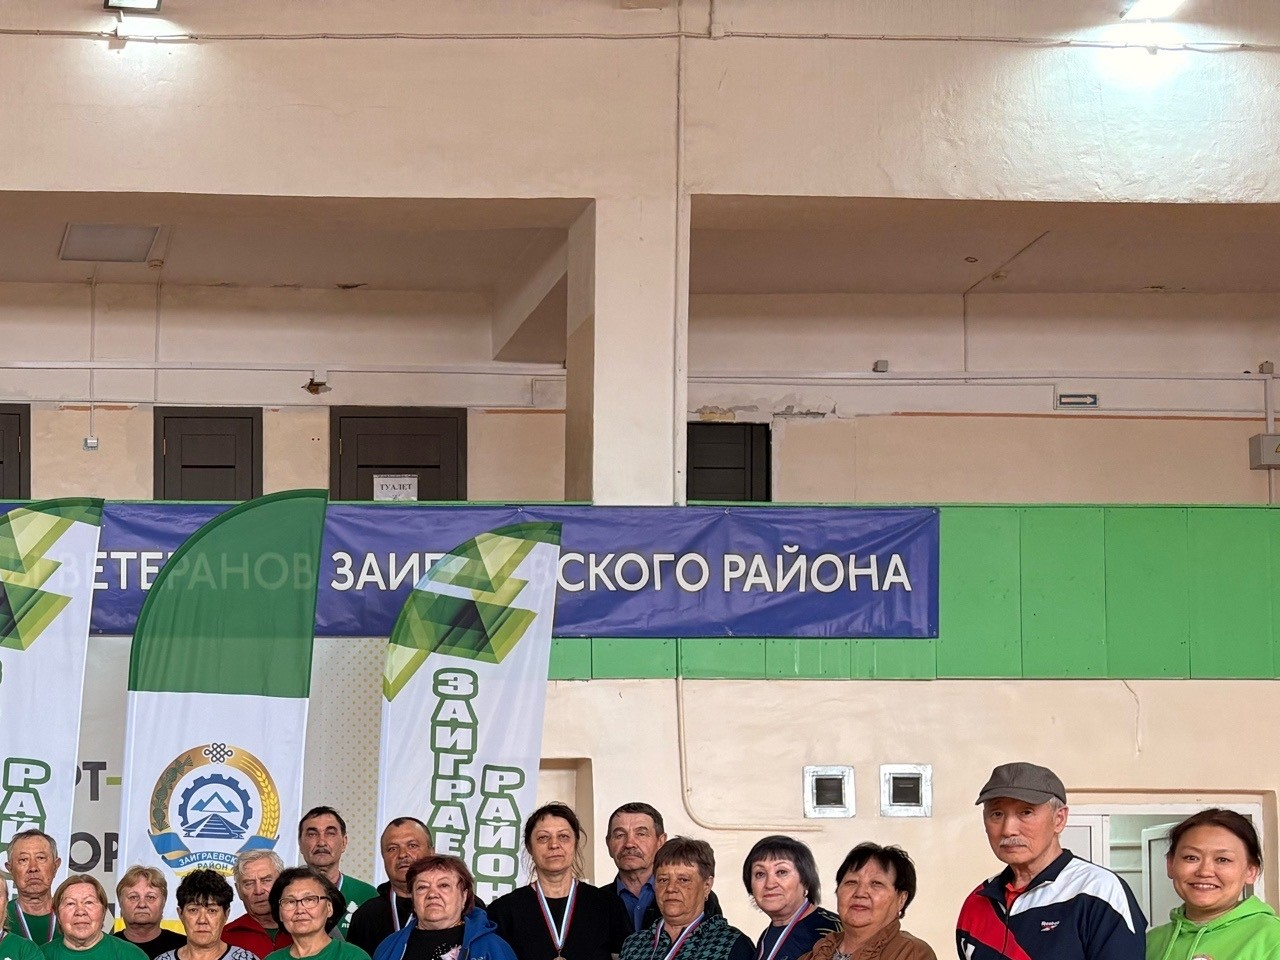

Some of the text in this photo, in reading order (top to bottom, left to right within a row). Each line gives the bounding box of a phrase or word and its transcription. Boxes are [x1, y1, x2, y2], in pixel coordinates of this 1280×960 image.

[380, 483, 412, 491] ТУАЛЕТ
[724, 545, 912, 592] РАЙОНА
[179, 852, 239, 867] ЗАИГРАЕВСК
[197, 862, 228, 871] РАЙОН
